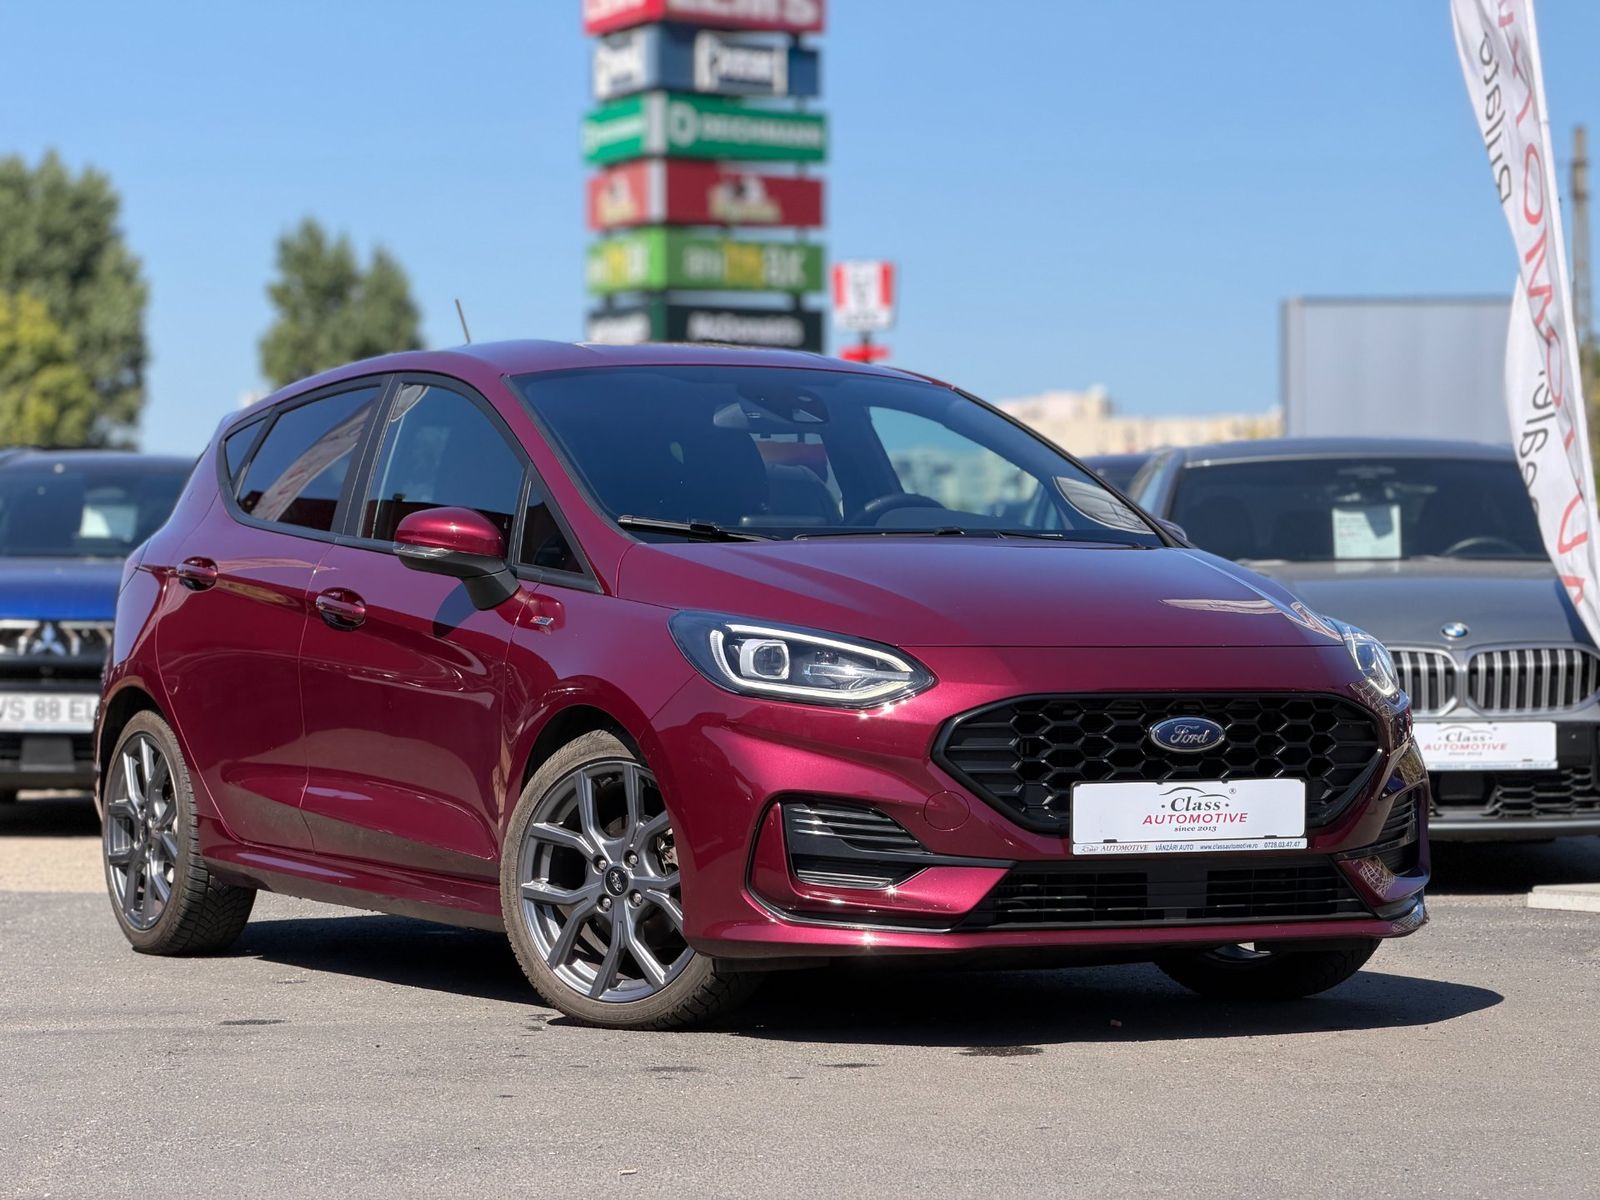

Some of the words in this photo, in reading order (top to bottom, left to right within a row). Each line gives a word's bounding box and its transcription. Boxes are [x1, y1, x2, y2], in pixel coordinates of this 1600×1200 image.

[1170, 724, 1211, 745] Ford
[1423, 742, 1508, 751] AUTOMOTIVE
[1170, 796, 1221, 812] Class
[1142, 812, 1249, 825] AUTOMOTIVE
[1197, 825, 1217, 833] 2013
[1100, 844, 1149, 852] AUTOMOTIVE
[1179, 843, 1194, 851] AUTO
